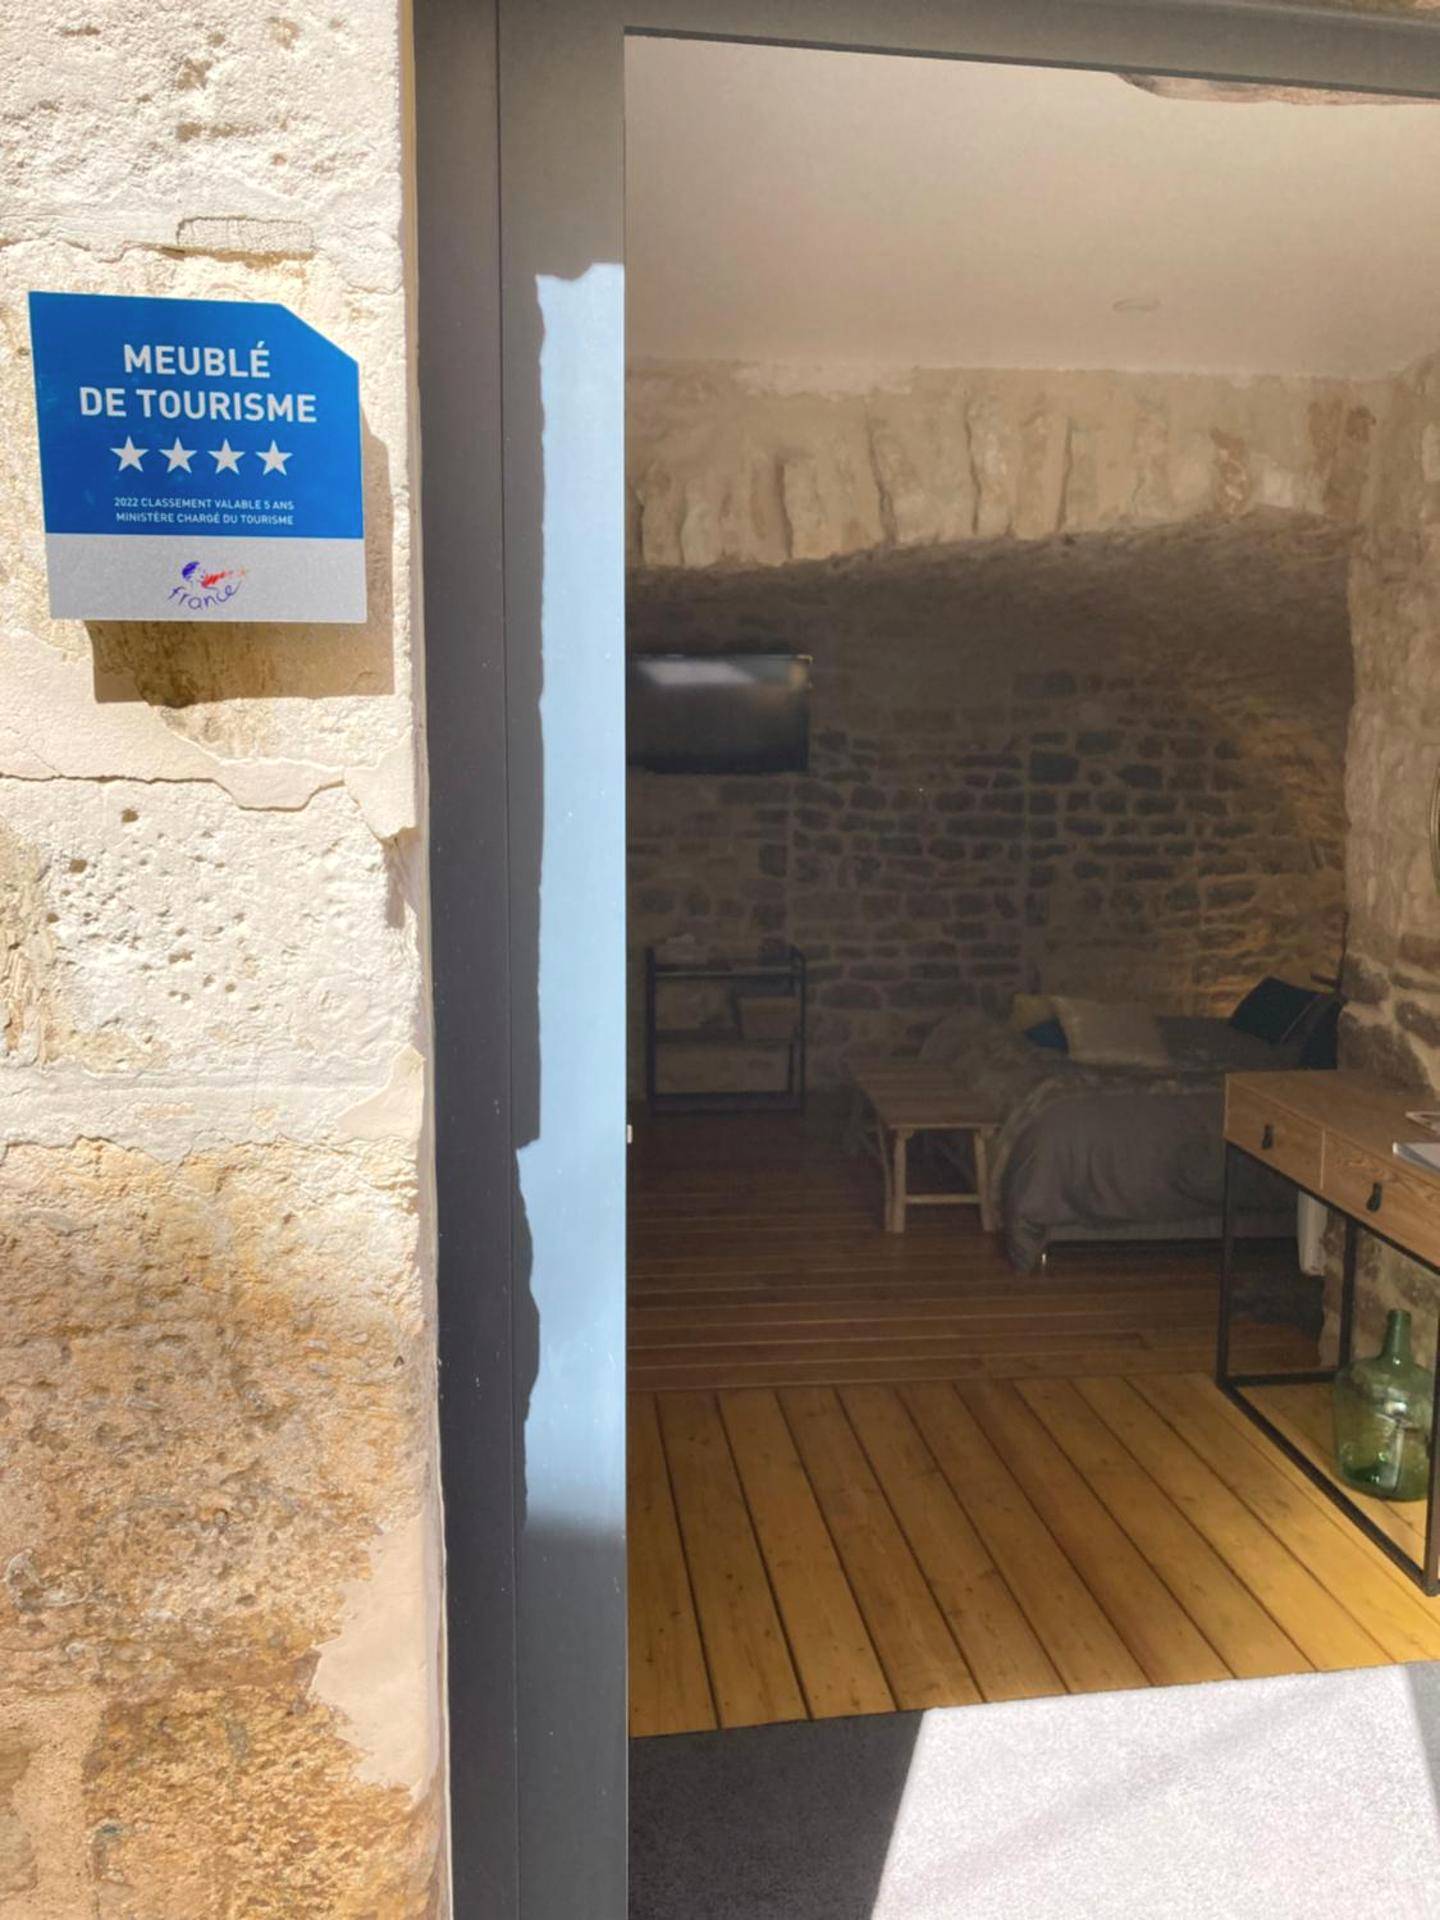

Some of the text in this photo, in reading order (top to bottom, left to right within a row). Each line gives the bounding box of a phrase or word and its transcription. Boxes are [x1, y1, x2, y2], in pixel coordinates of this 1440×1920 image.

[124, 341, 270, 378] MEUBLÉ
[80, 387, 317, 423] DE TOURISME
[114, 497, 295, 511] 2022 CLASSEMENT VALABLE 5 ANS
[116, 510, 294, 526] MINISTÈRE CHARGÉ DU TOURISME
